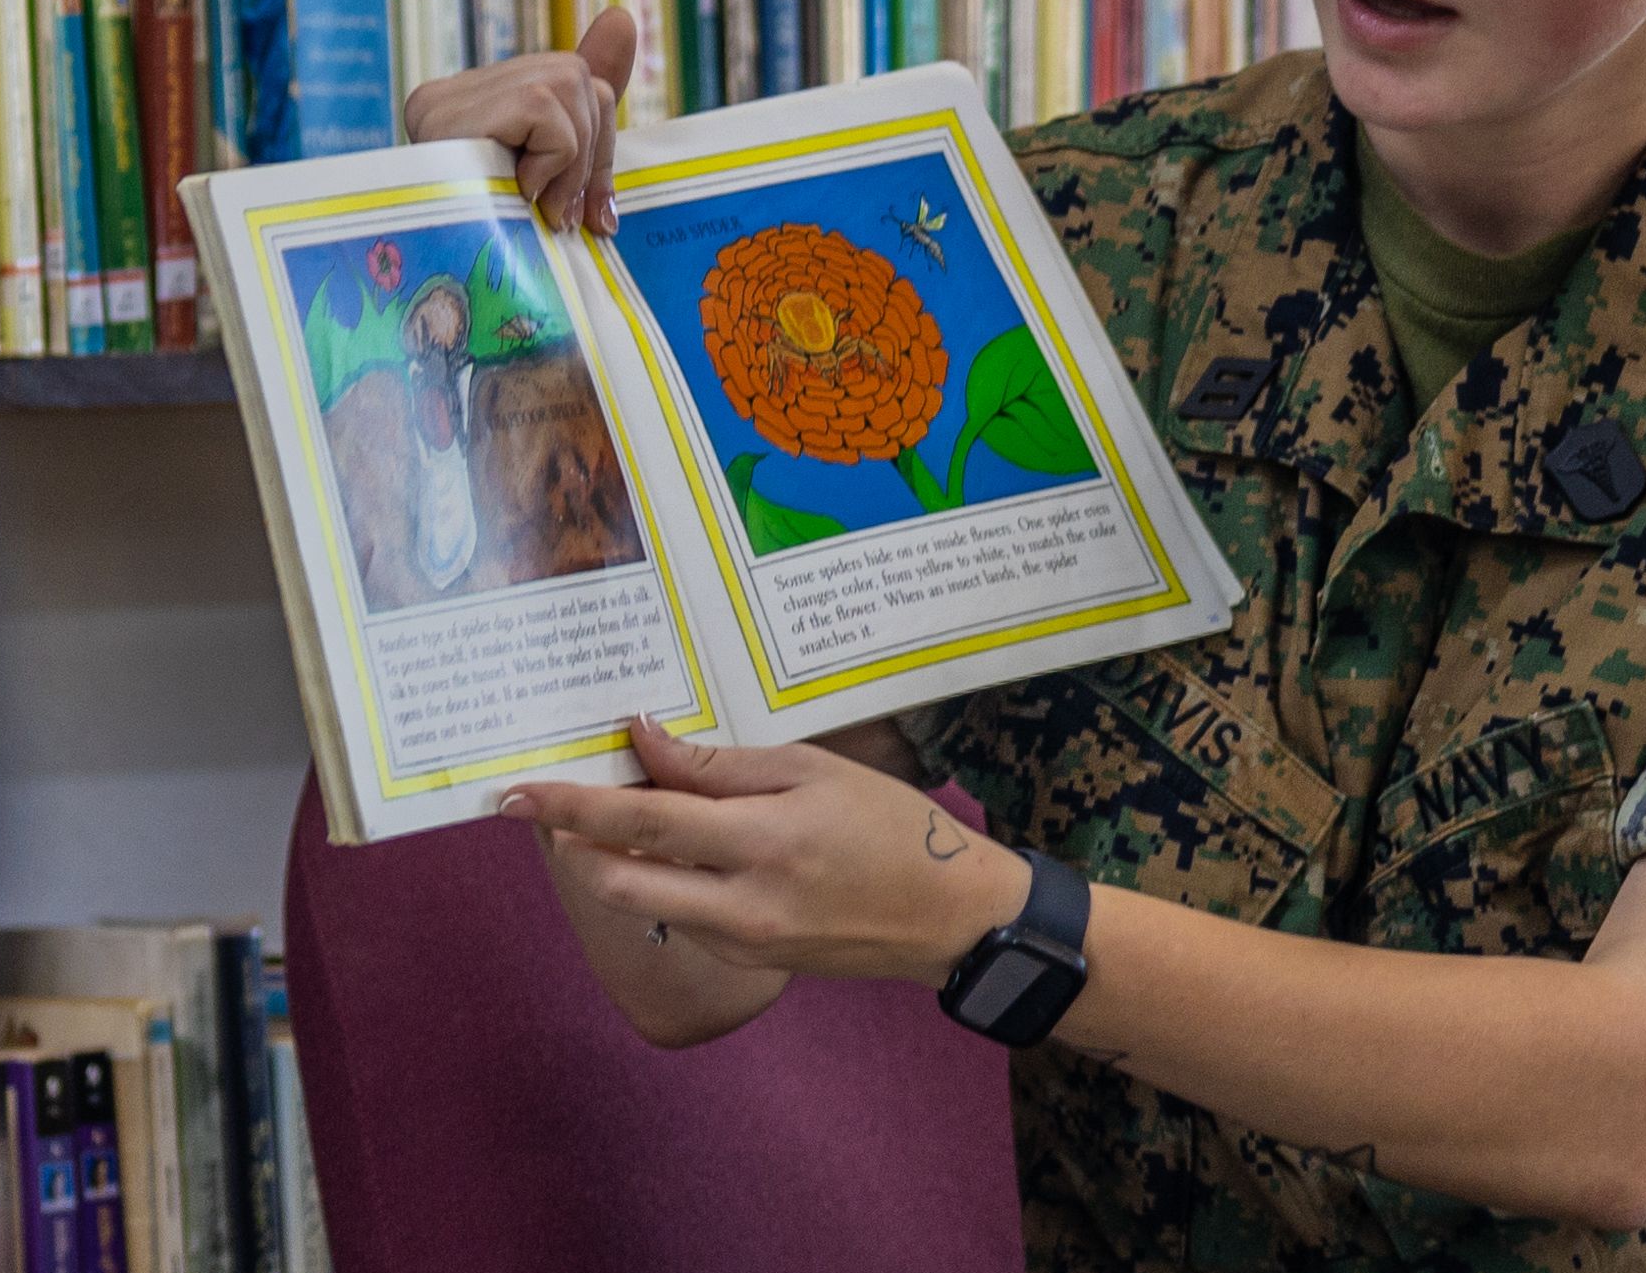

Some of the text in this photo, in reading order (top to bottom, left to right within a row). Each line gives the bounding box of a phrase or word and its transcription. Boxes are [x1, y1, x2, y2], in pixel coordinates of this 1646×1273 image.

[646, 229, 687, 248] CRAB
[773, 502, 1111, 591] Some spiders hide on or inside flowers. One spider even
[783, 519, 1117, 613] changes color, from yellow to white, to match the color
[791, 550, 1077, 634] of the flower. When an insect lands, the spider
[797, 621, 875, 654] snatches it.
[1102, 652, 1243, 769] DAVIS
[1411, 730, 1556, 835] NAVY
